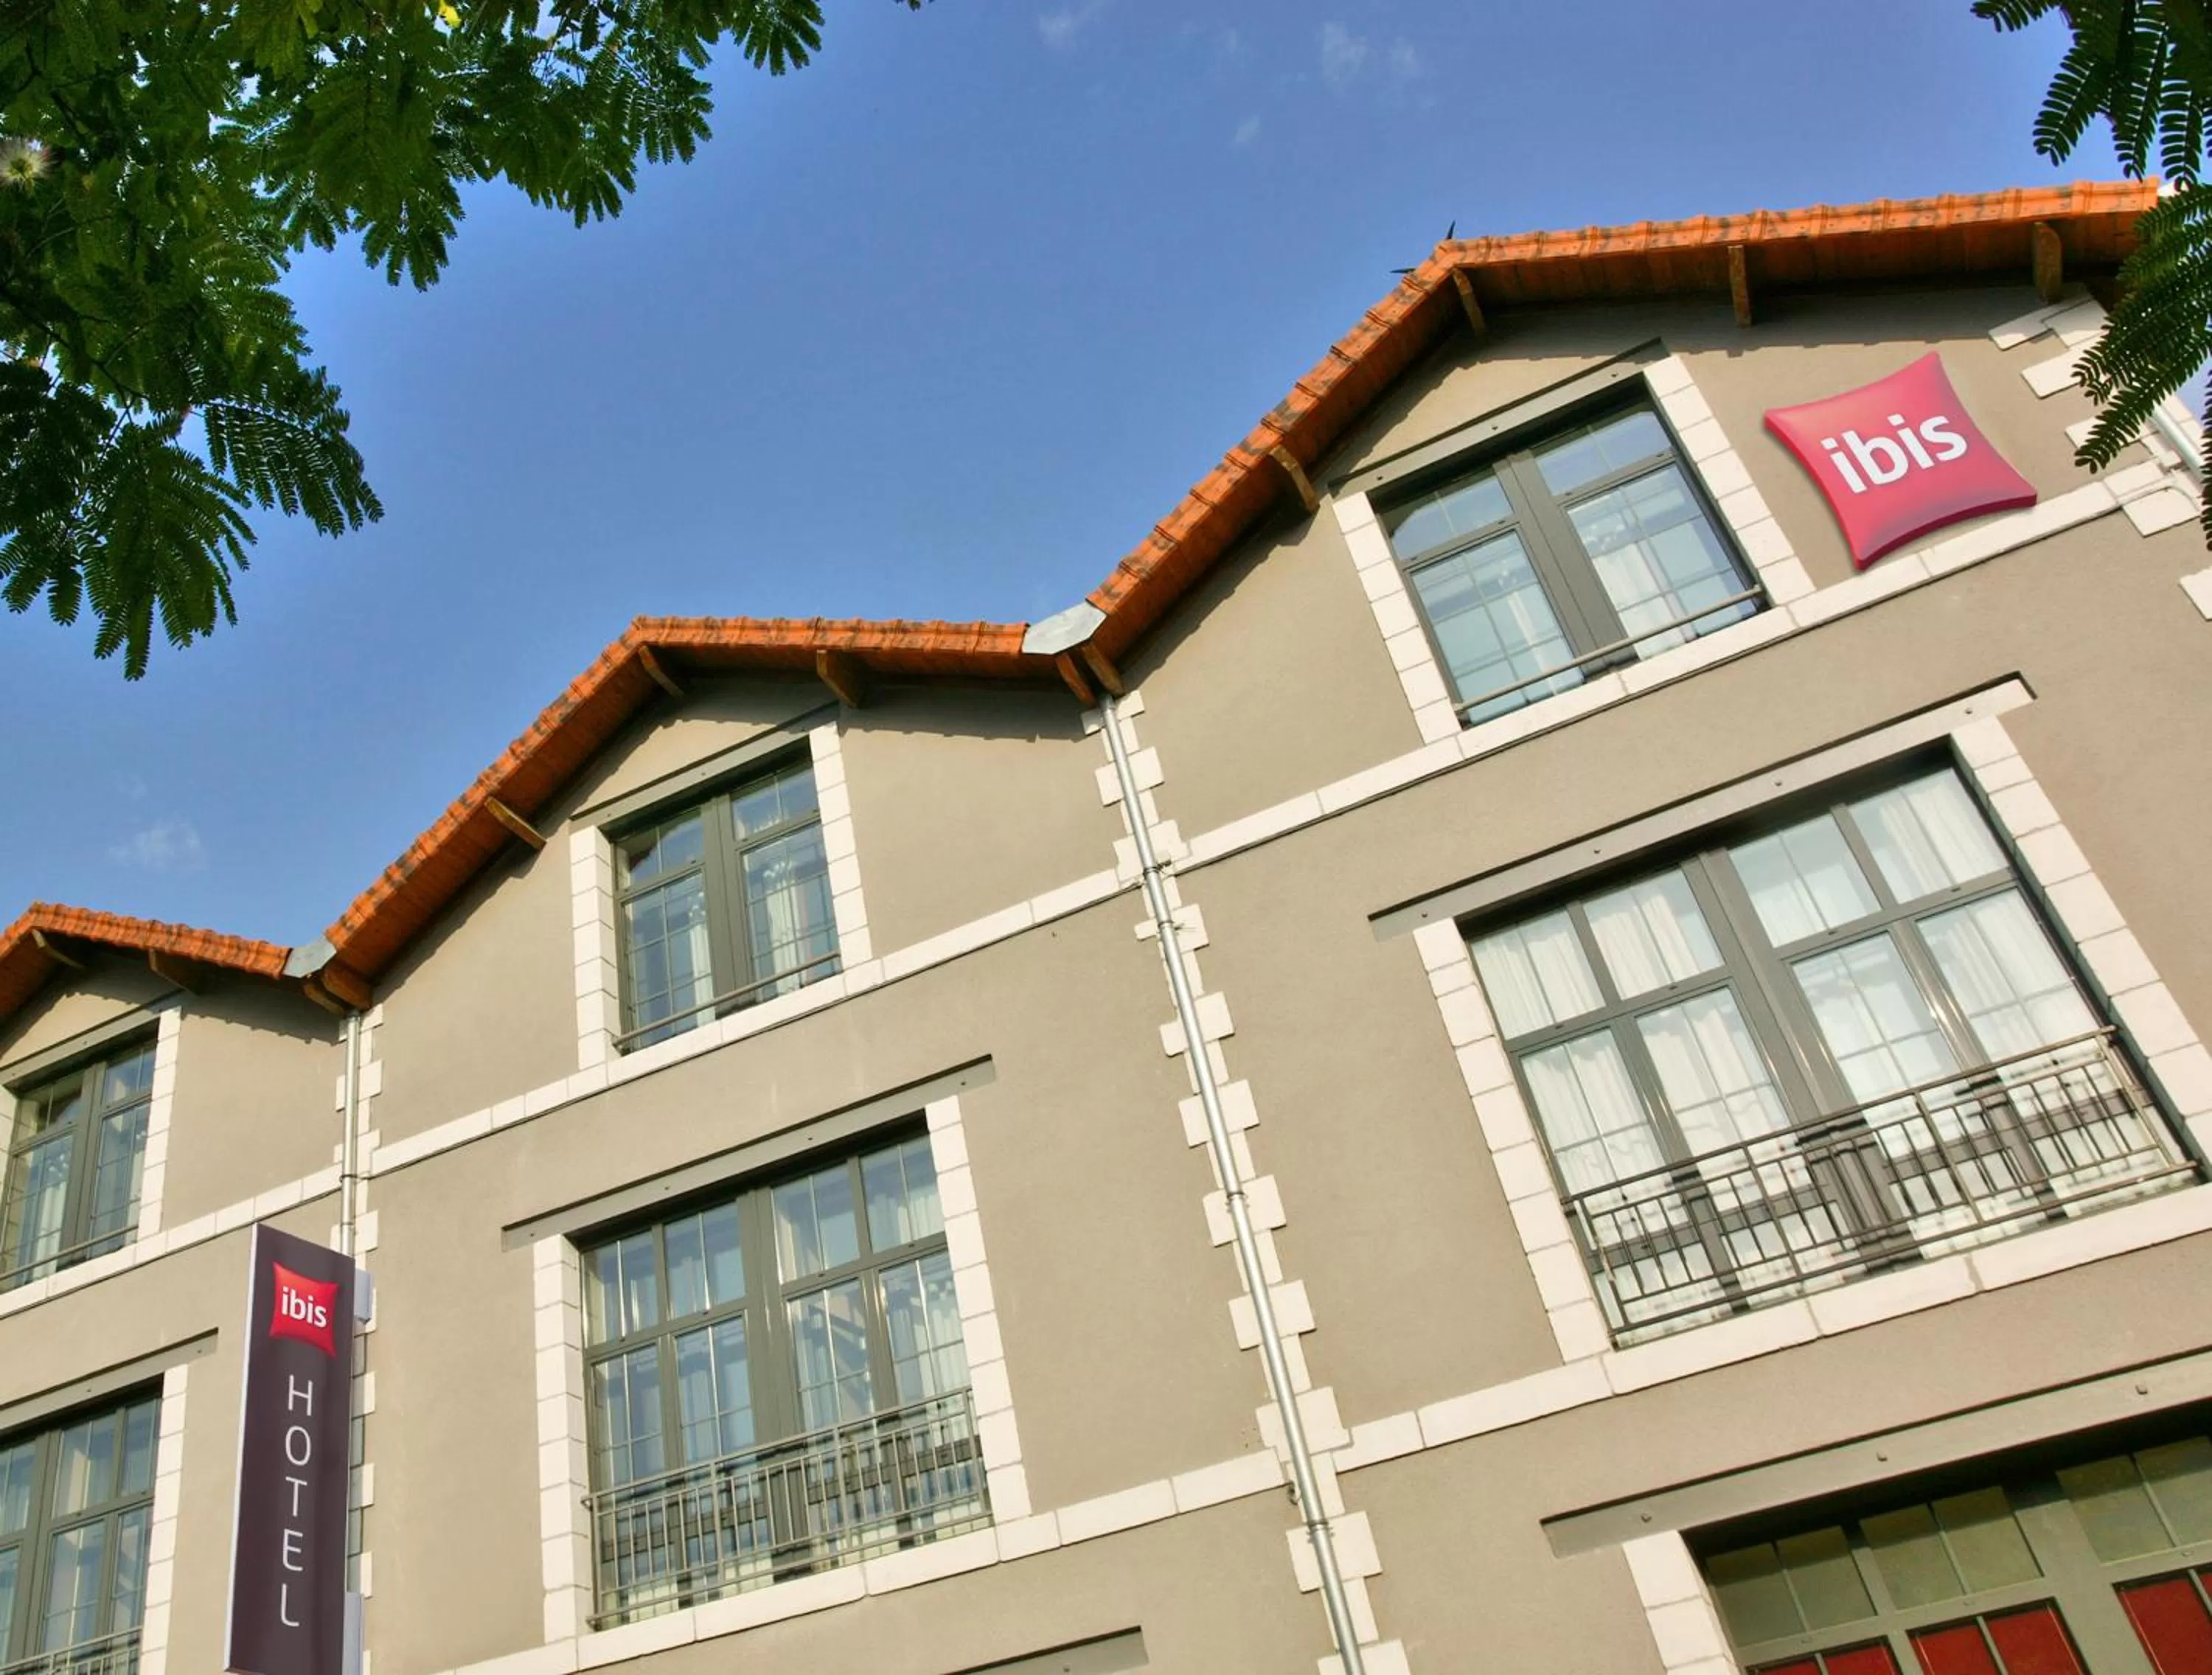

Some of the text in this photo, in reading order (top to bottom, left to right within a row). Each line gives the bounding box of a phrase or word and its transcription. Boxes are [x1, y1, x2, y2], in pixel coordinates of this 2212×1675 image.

[1821, 414, 1968, 493] ibis
[282, 1286, 327, 1328] ibis
[280, 1375, 313, 1627] HOTEL
